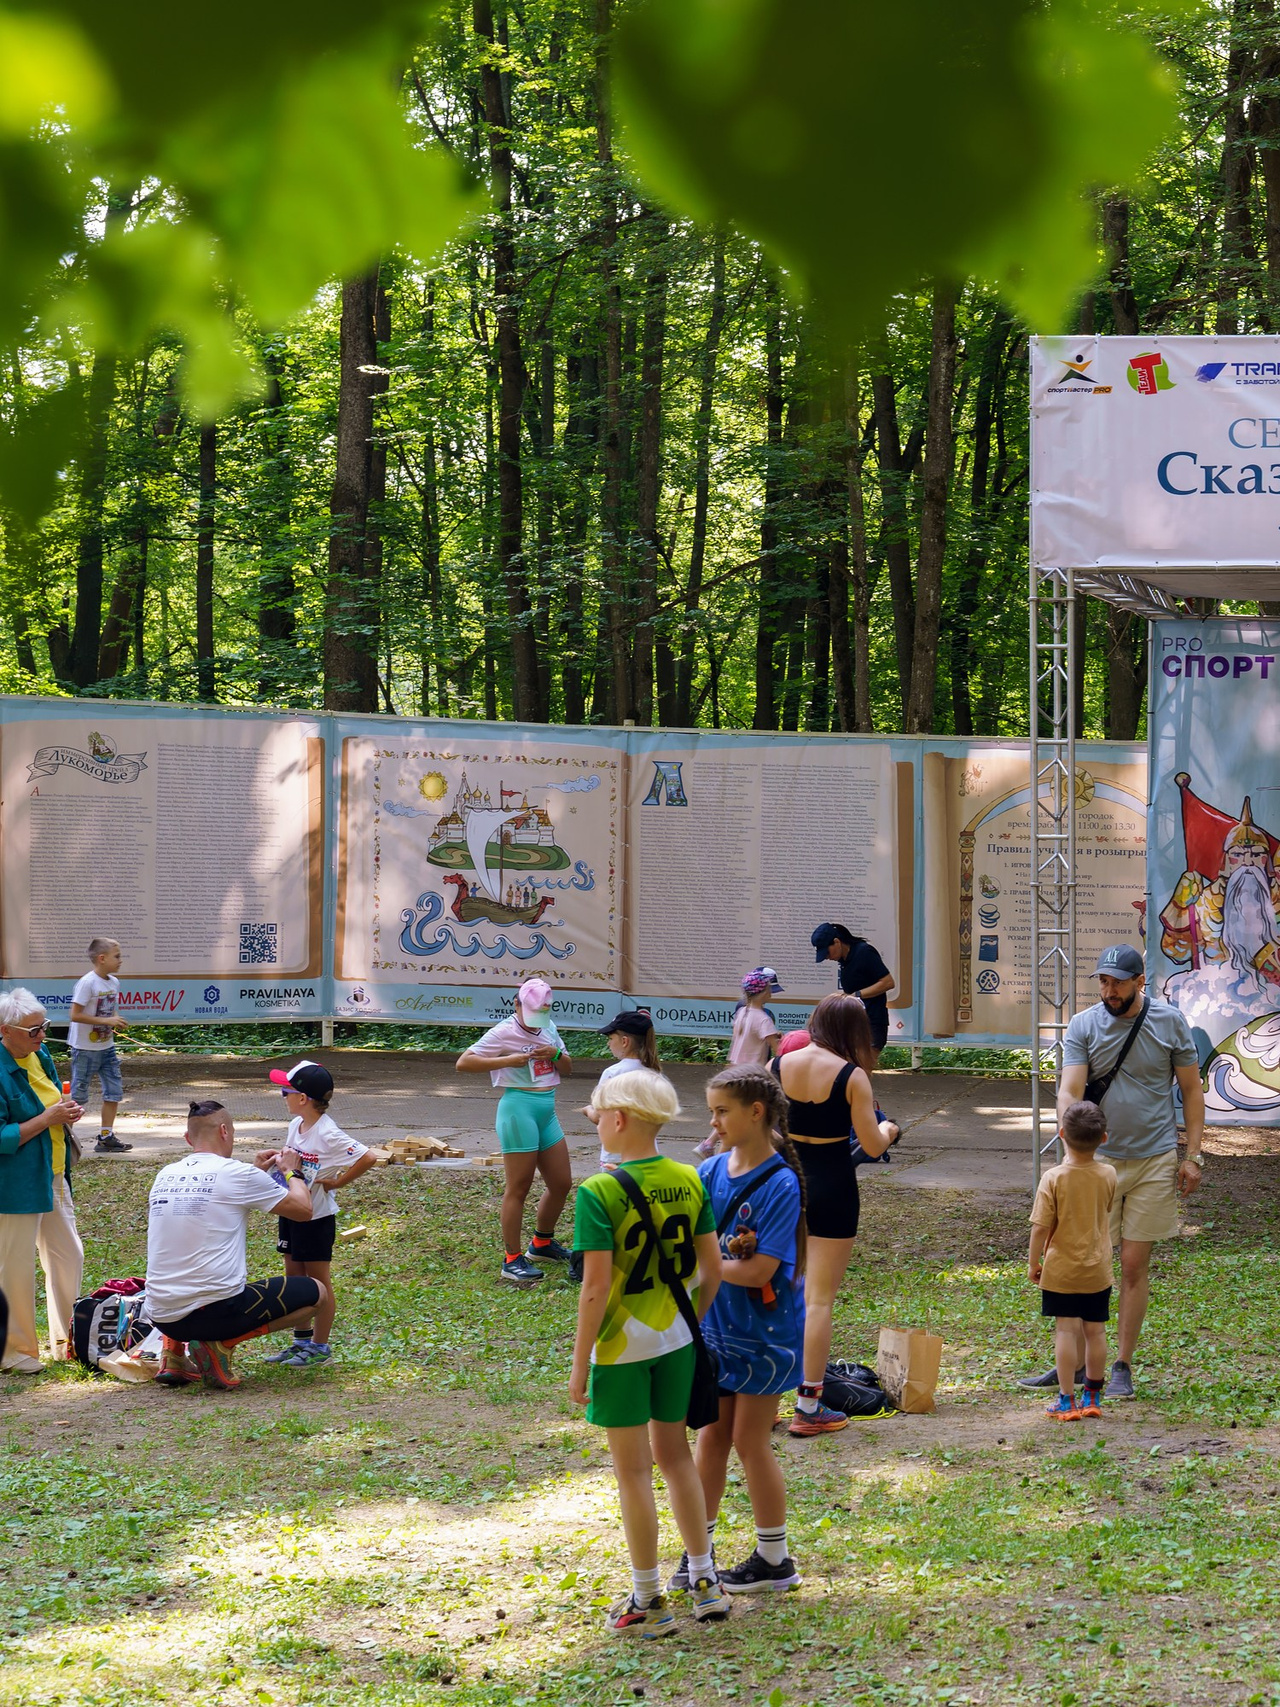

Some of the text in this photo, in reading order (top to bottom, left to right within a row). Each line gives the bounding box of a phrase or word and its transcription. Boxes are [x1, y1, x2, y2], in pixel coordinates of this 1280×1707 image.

[1093, 386, 1112, 394] PRO
[1162, 637, 1203, 651] PRO
[1162, 655, 1275, 679] СПОРТ
[48, 750, 128, 781] Лукоморье
[1078, 813, 1114, 822] городок
[1007, 821, 1031, 830] врем
[1077, 821, 1099, 830] 11:00
[1100, 823, 1112, 831] до
[1114, 822, 1136, 831] 13.30
[987, 844, 1032, 855] Правил
[118, 991, 162, 1005] МАРК
[239, 987, 316, 999] PRAVILNAYA
[254, 999, 301, 1008] KOSMETIKA
[395, 994, 473, 1011] Art STONE
[551, 1000, 605, 1016] evrana
[194, 1006, 228, 1014] НОВАЯ ВОДА
[655, 1008, 735, 1023] ФОРАБАНК
[624, 1213, 697, 1290] 23
